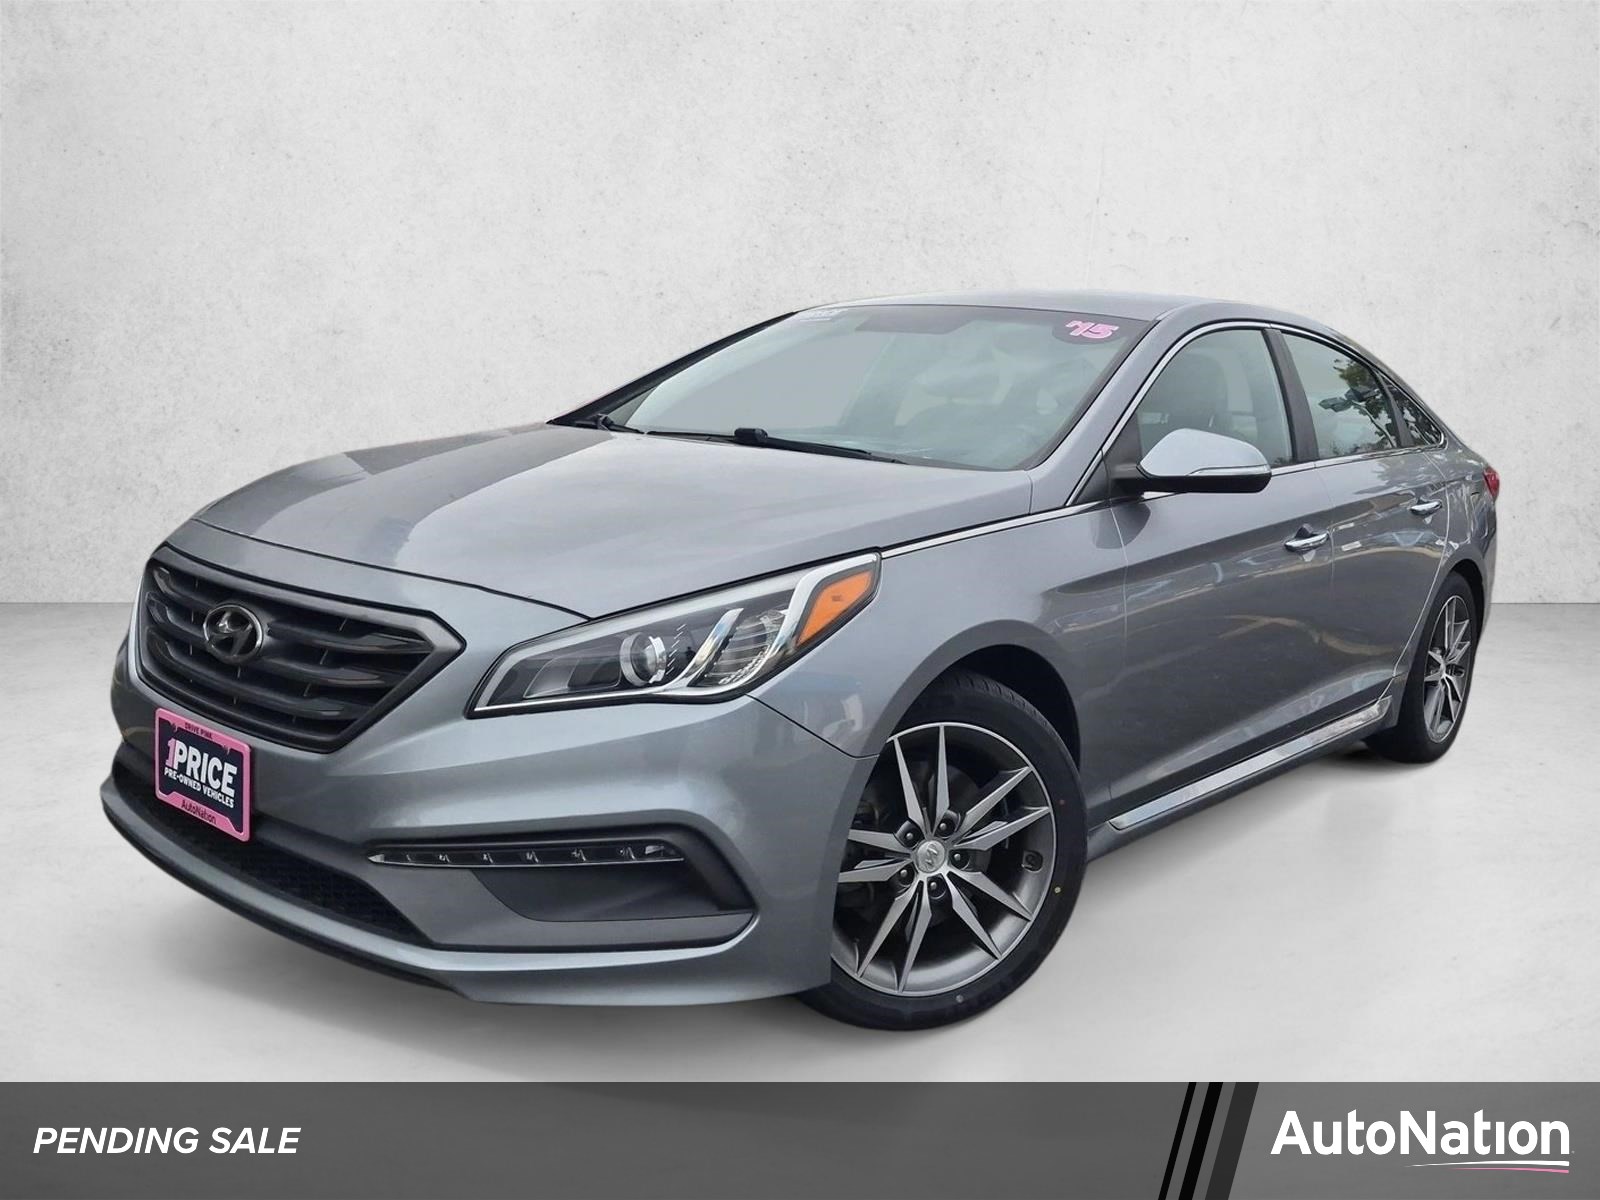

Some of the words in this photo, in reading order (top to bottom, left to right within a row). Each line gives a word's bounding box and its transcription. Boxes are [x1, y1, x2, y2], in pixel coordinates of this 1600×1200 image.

[164, 767, 201, 792] PRE-OWNED
[202, 784, 235, 808] VEHICLES
[181, 800, 217, 825] AutoNation
